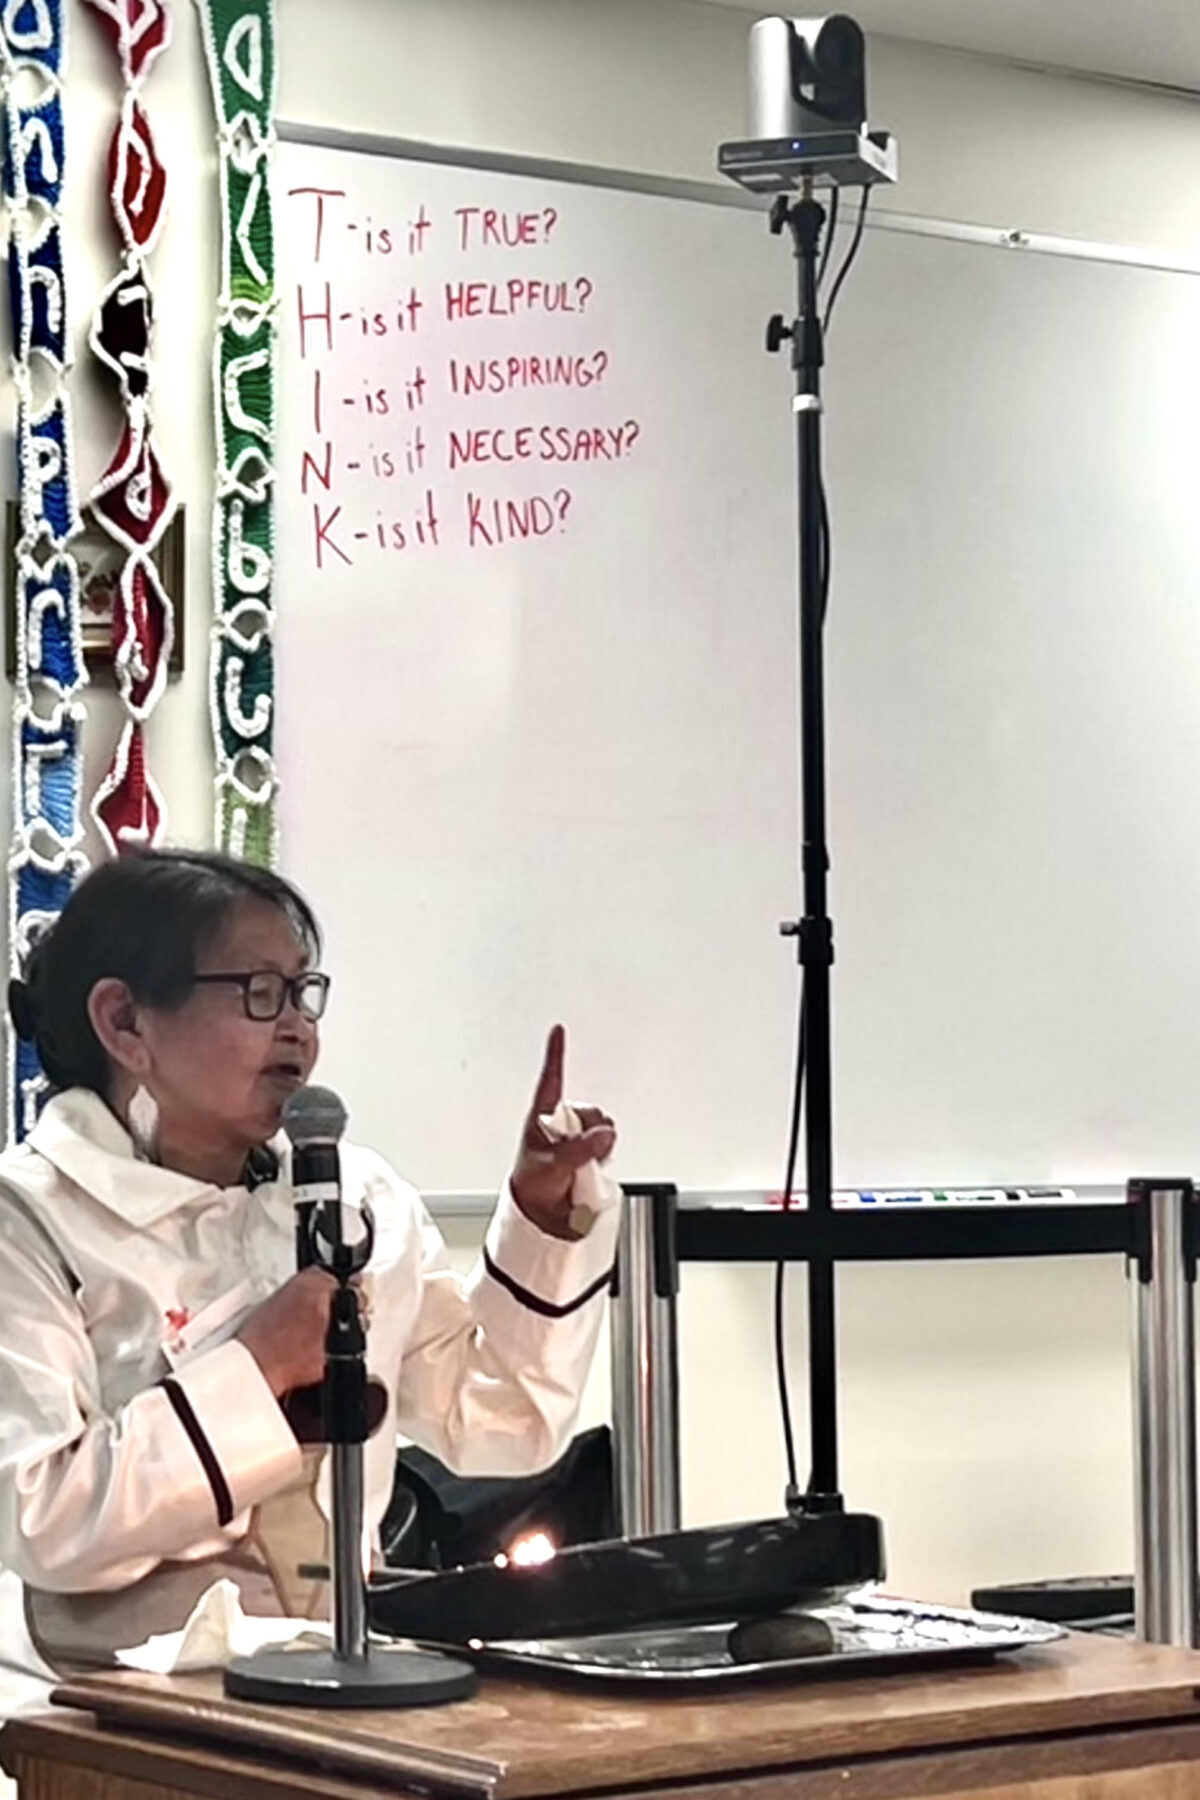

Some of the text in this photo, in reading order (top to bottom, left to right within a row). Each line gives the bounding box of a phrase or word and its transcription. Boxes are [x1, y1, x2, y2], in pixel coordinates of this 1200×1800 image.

[408, 205, 432, 256] it
[454, 207, 558, 252] TRUE?
[397, 287, 423, 333] it
[444, 276, 593, 322] HELPFUL?
[405, 366, 427, 411] it
[449, 350, 609, 395] INSPIRING?
[406, 426, 426, 475] it
[448, 419, 641, 471] NECESSARY?
[415, 489, 439, 546] it
[467, 488, 572, 548] KIND?
